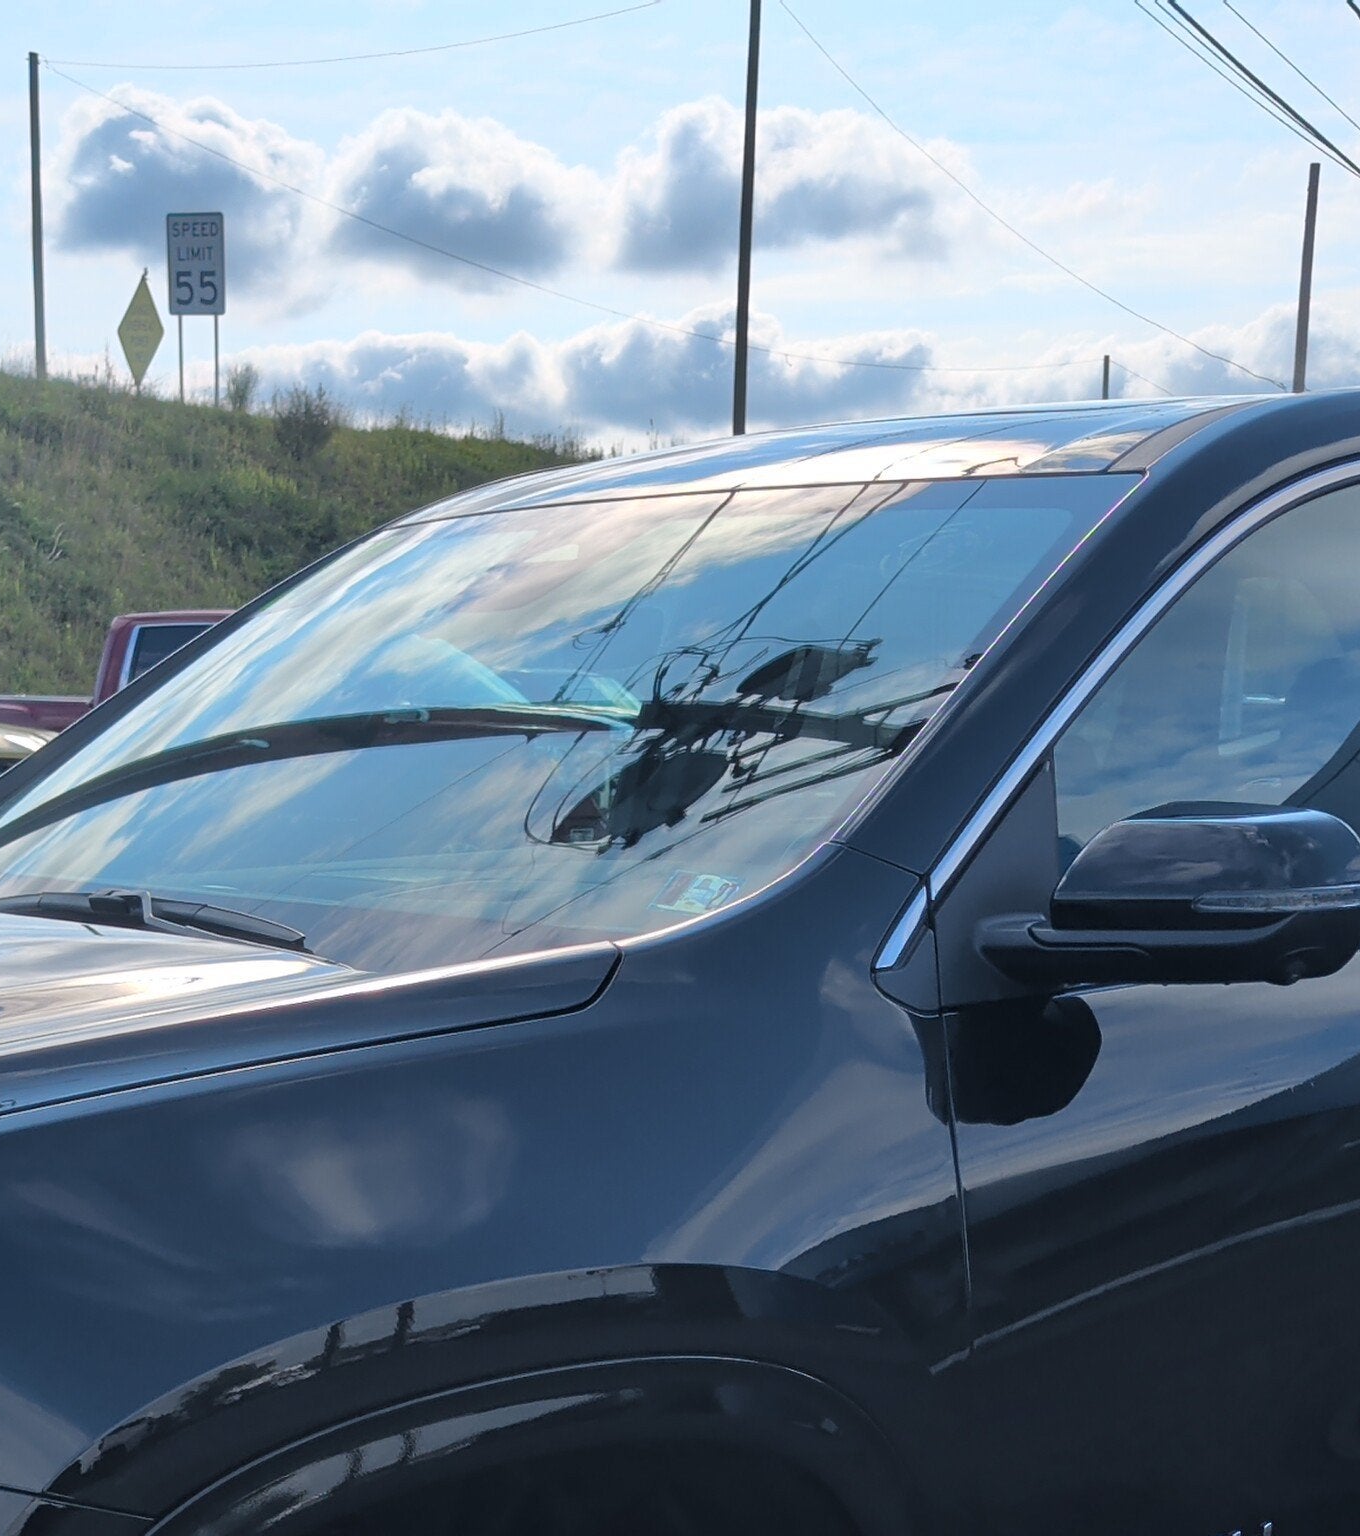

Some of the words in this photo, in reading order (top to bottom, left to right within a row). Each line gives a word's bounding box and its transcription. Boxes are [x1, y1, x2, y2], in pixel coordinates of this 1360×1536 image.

[171, 222, 219, 238] SPEED
[177, 247, 214, 262] LIMIT
[175, 270, 218, 306] 55
